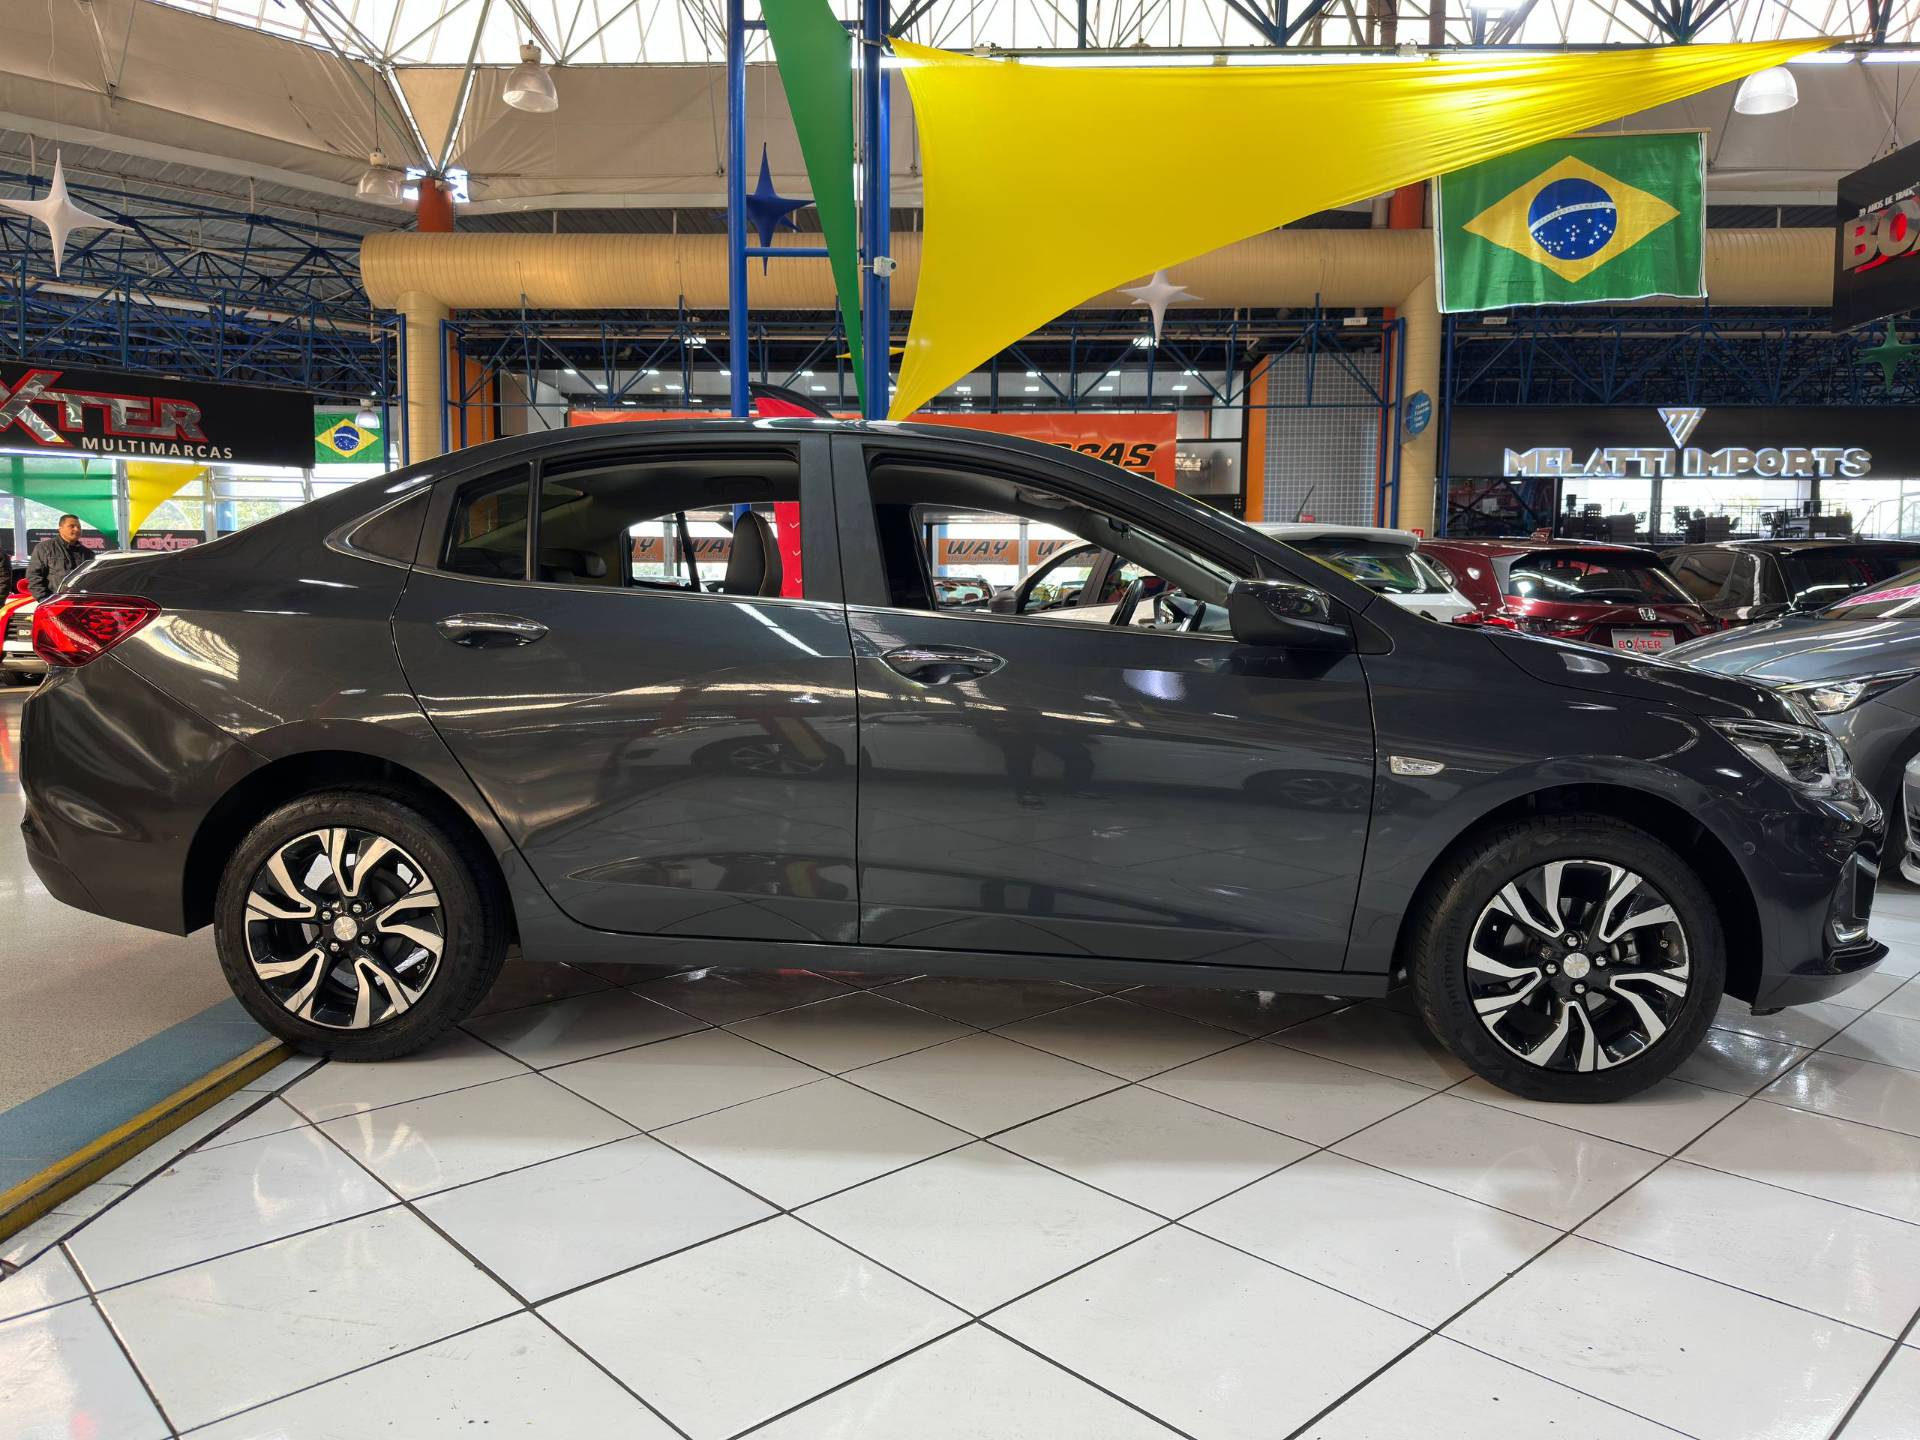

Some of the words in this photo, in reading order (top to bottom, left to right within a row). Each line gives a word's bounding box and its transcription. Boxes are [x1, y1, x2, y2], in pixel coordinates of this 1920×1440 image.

[82, 437, 233, 459] MULTIMARCAS
[1503, 447, 1676, 477] MELATTI
[1683, 447, 1873, 477] IMPORTS
[947, 540, 1009, 555] WAY
[1618, 635, 1663, 652] BOXTER
